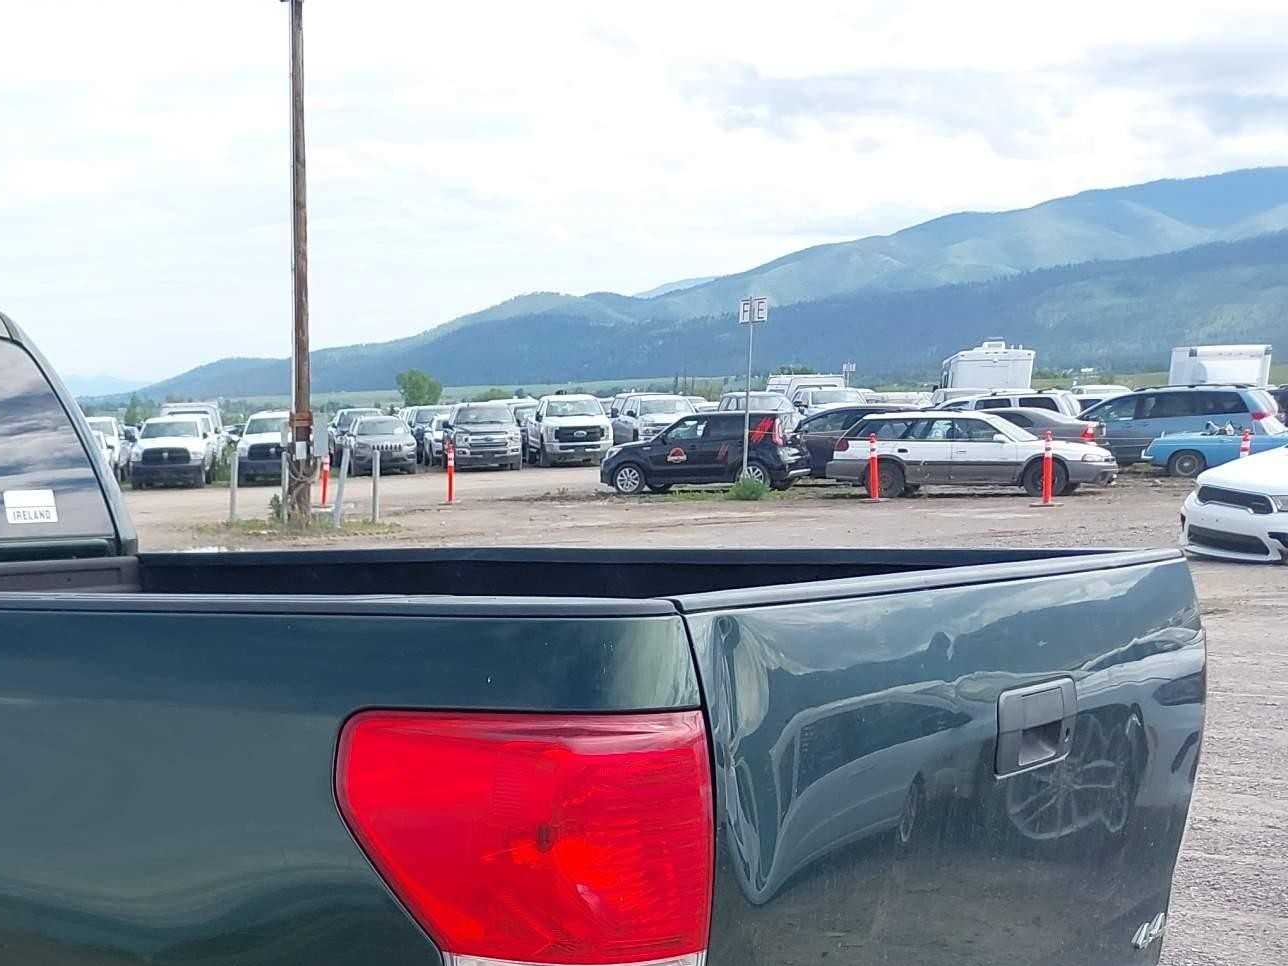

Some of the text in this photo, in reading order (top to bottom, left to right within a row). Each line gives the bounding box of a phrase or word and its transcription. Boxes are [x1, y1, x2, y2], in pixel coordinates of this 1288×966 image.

[742, 301, 765, 320] F E
[12, 509, 51, 521] IRELAND
